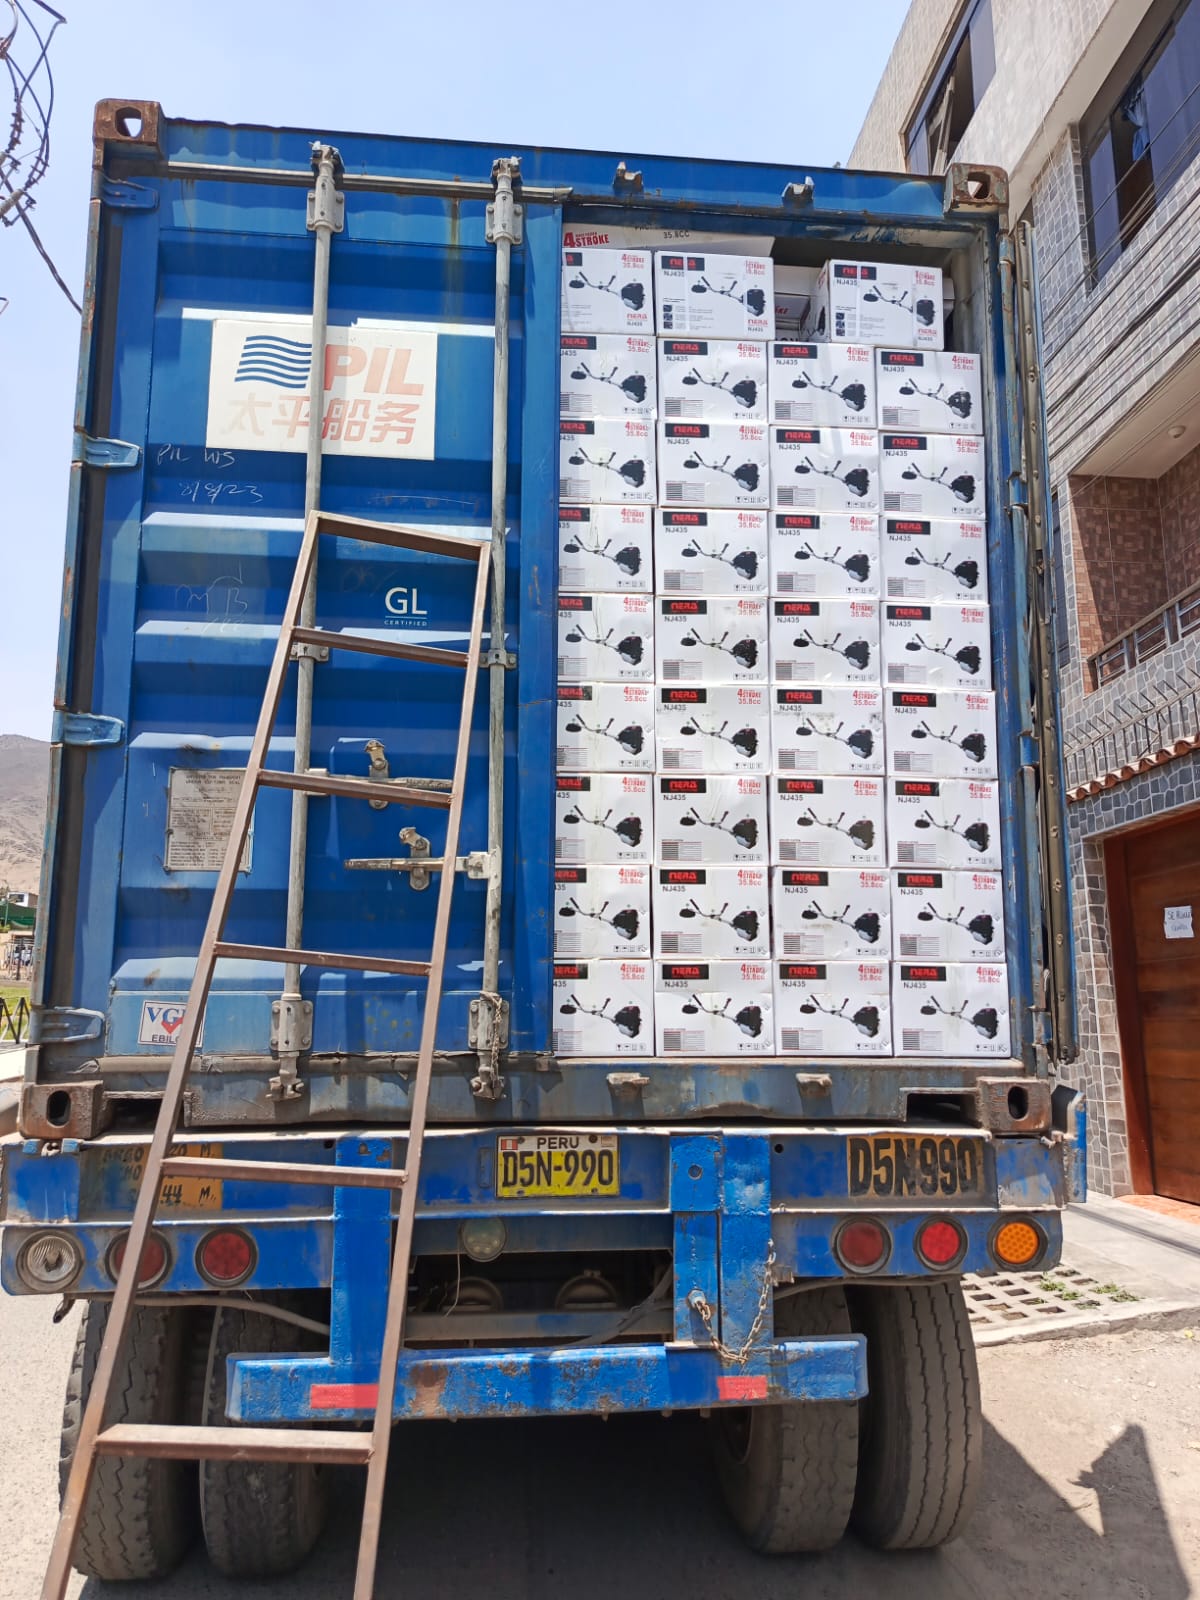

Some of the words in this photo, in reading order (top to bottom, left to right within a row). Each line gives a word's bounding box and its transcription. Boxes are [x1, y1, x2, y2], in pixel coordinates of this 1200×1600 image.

[563, 232, 575, 248] 4
[575, 234, 609, 247] STROKE
[324, 343, 424, 396] PIL
[385, 586, 428, 615] GL
[384, 619, 428, 627] CERTIFIED
[537, 1137, 580, 1150] PERU
[502, 1149, 614, 1187] D5N-990
[849, 1137, 978, 1197] D5N990
